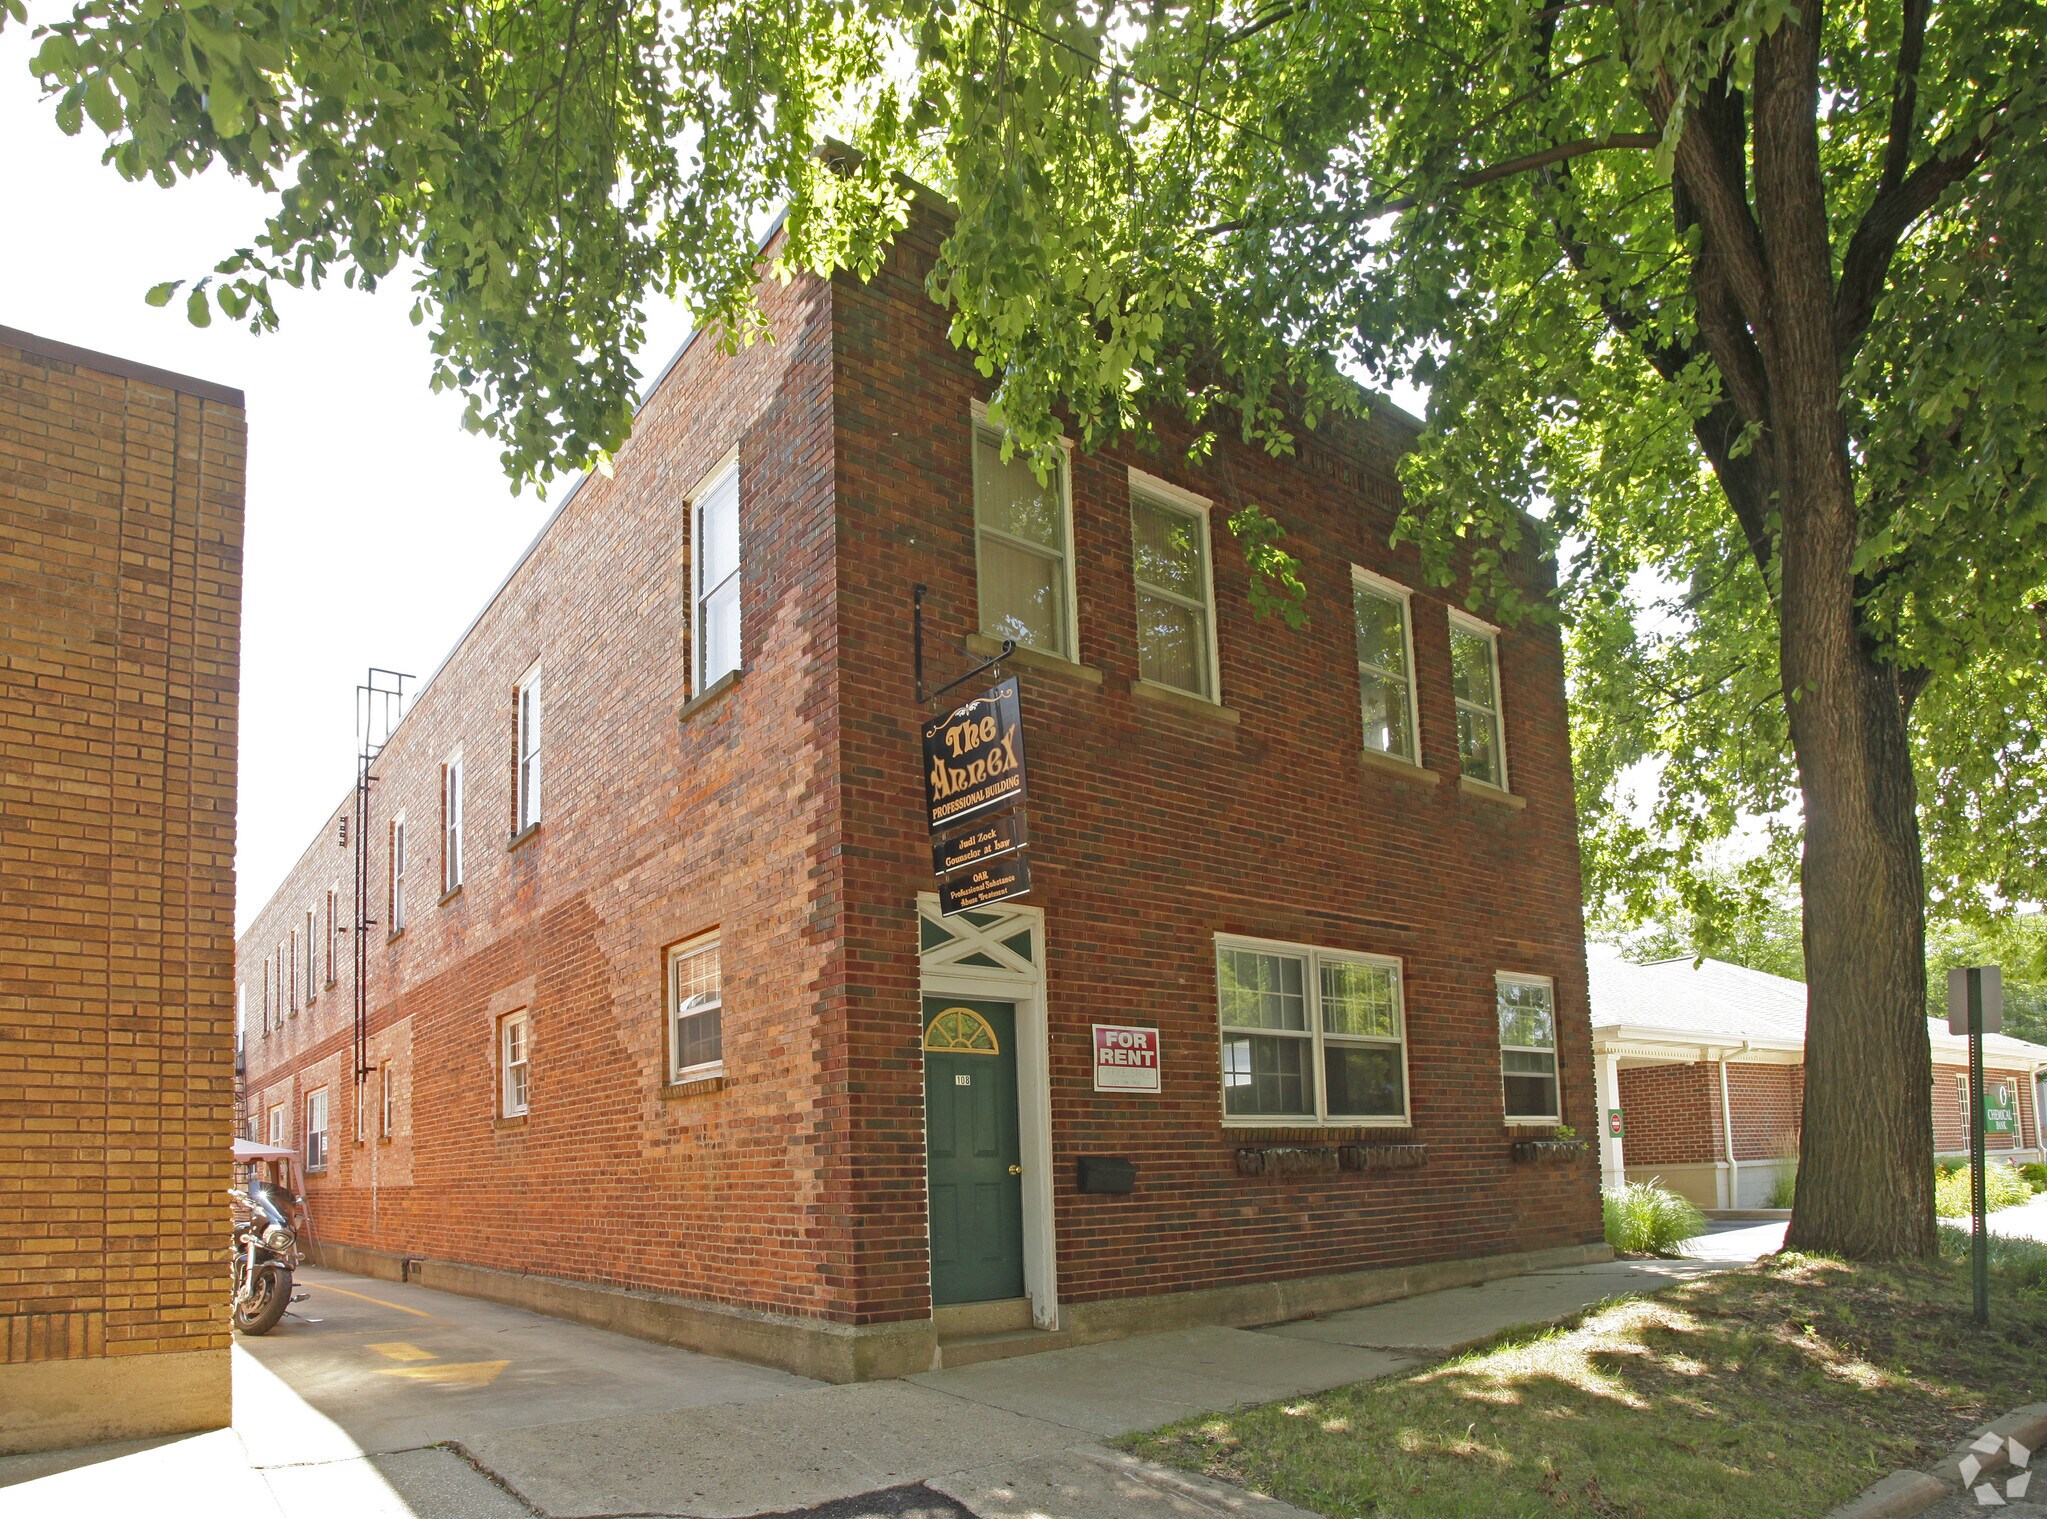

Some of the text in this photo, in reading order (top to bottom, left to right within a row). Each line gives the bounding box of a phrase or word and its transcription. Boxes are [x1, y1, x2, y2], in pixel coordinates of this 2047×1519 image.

[946, 716, 996, 758] The
[932, 774, 1020, 820] PROFESSIONAL BUILDING
[959, 836, 976, 849] Judi
[984, 844, 992, 854] at
[994, 839, 1011, 851] Law
[973, 871, 989, 883] OAR
[950, 875, 1016, 900] Professional Substance
[960, 888, 1008, 907] Abuse Treatment
[1105, 1031, 1147, 1049] FOR
[1100, 1048, 1155, 1066] RENT
[1987, 1109, 2012, 1120] CHEMICAL
[1996, 1121, 2007, 1129] BANK
